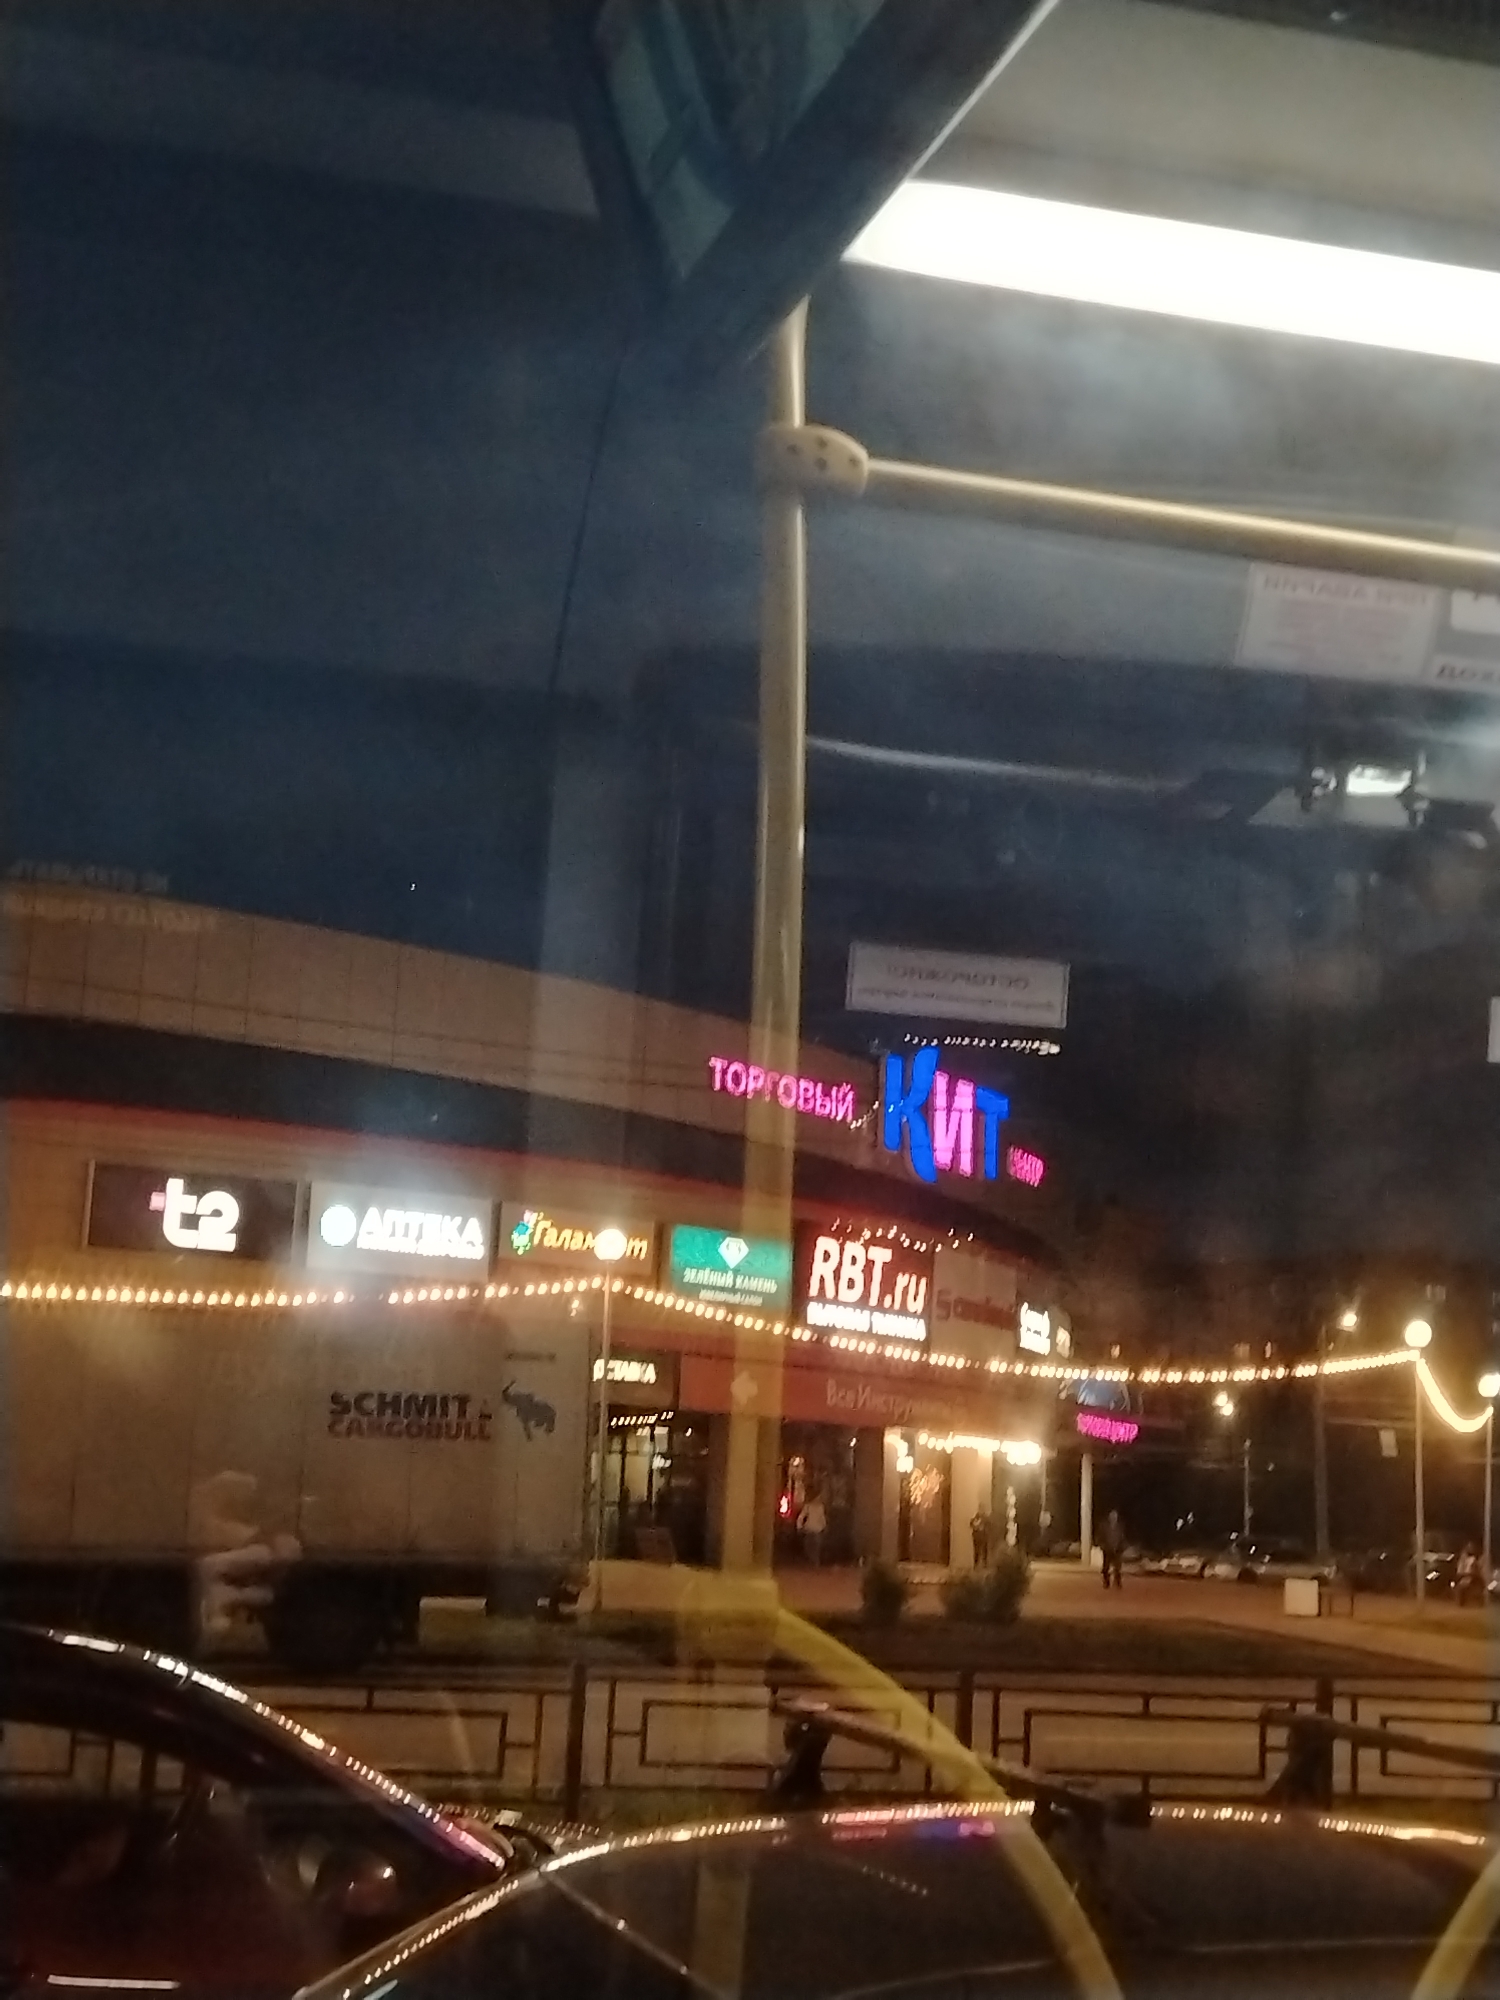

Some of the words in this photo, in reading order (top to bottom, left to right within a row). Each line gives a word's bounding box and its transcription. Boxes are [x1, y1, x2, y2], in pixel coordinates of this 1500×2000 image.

[709, 1057, 855, 1122] ТОРГОВЫЙ
[884, 1046, 1009, 1183] КИТ
[150, 1178, 240, 1252] t2
[357, 1207, 483, 1248] АПТЕКА
[735, 1275, 778, 1294] КАМЕНЬ
[809, 1236, 927, 1314] RBT.ru
